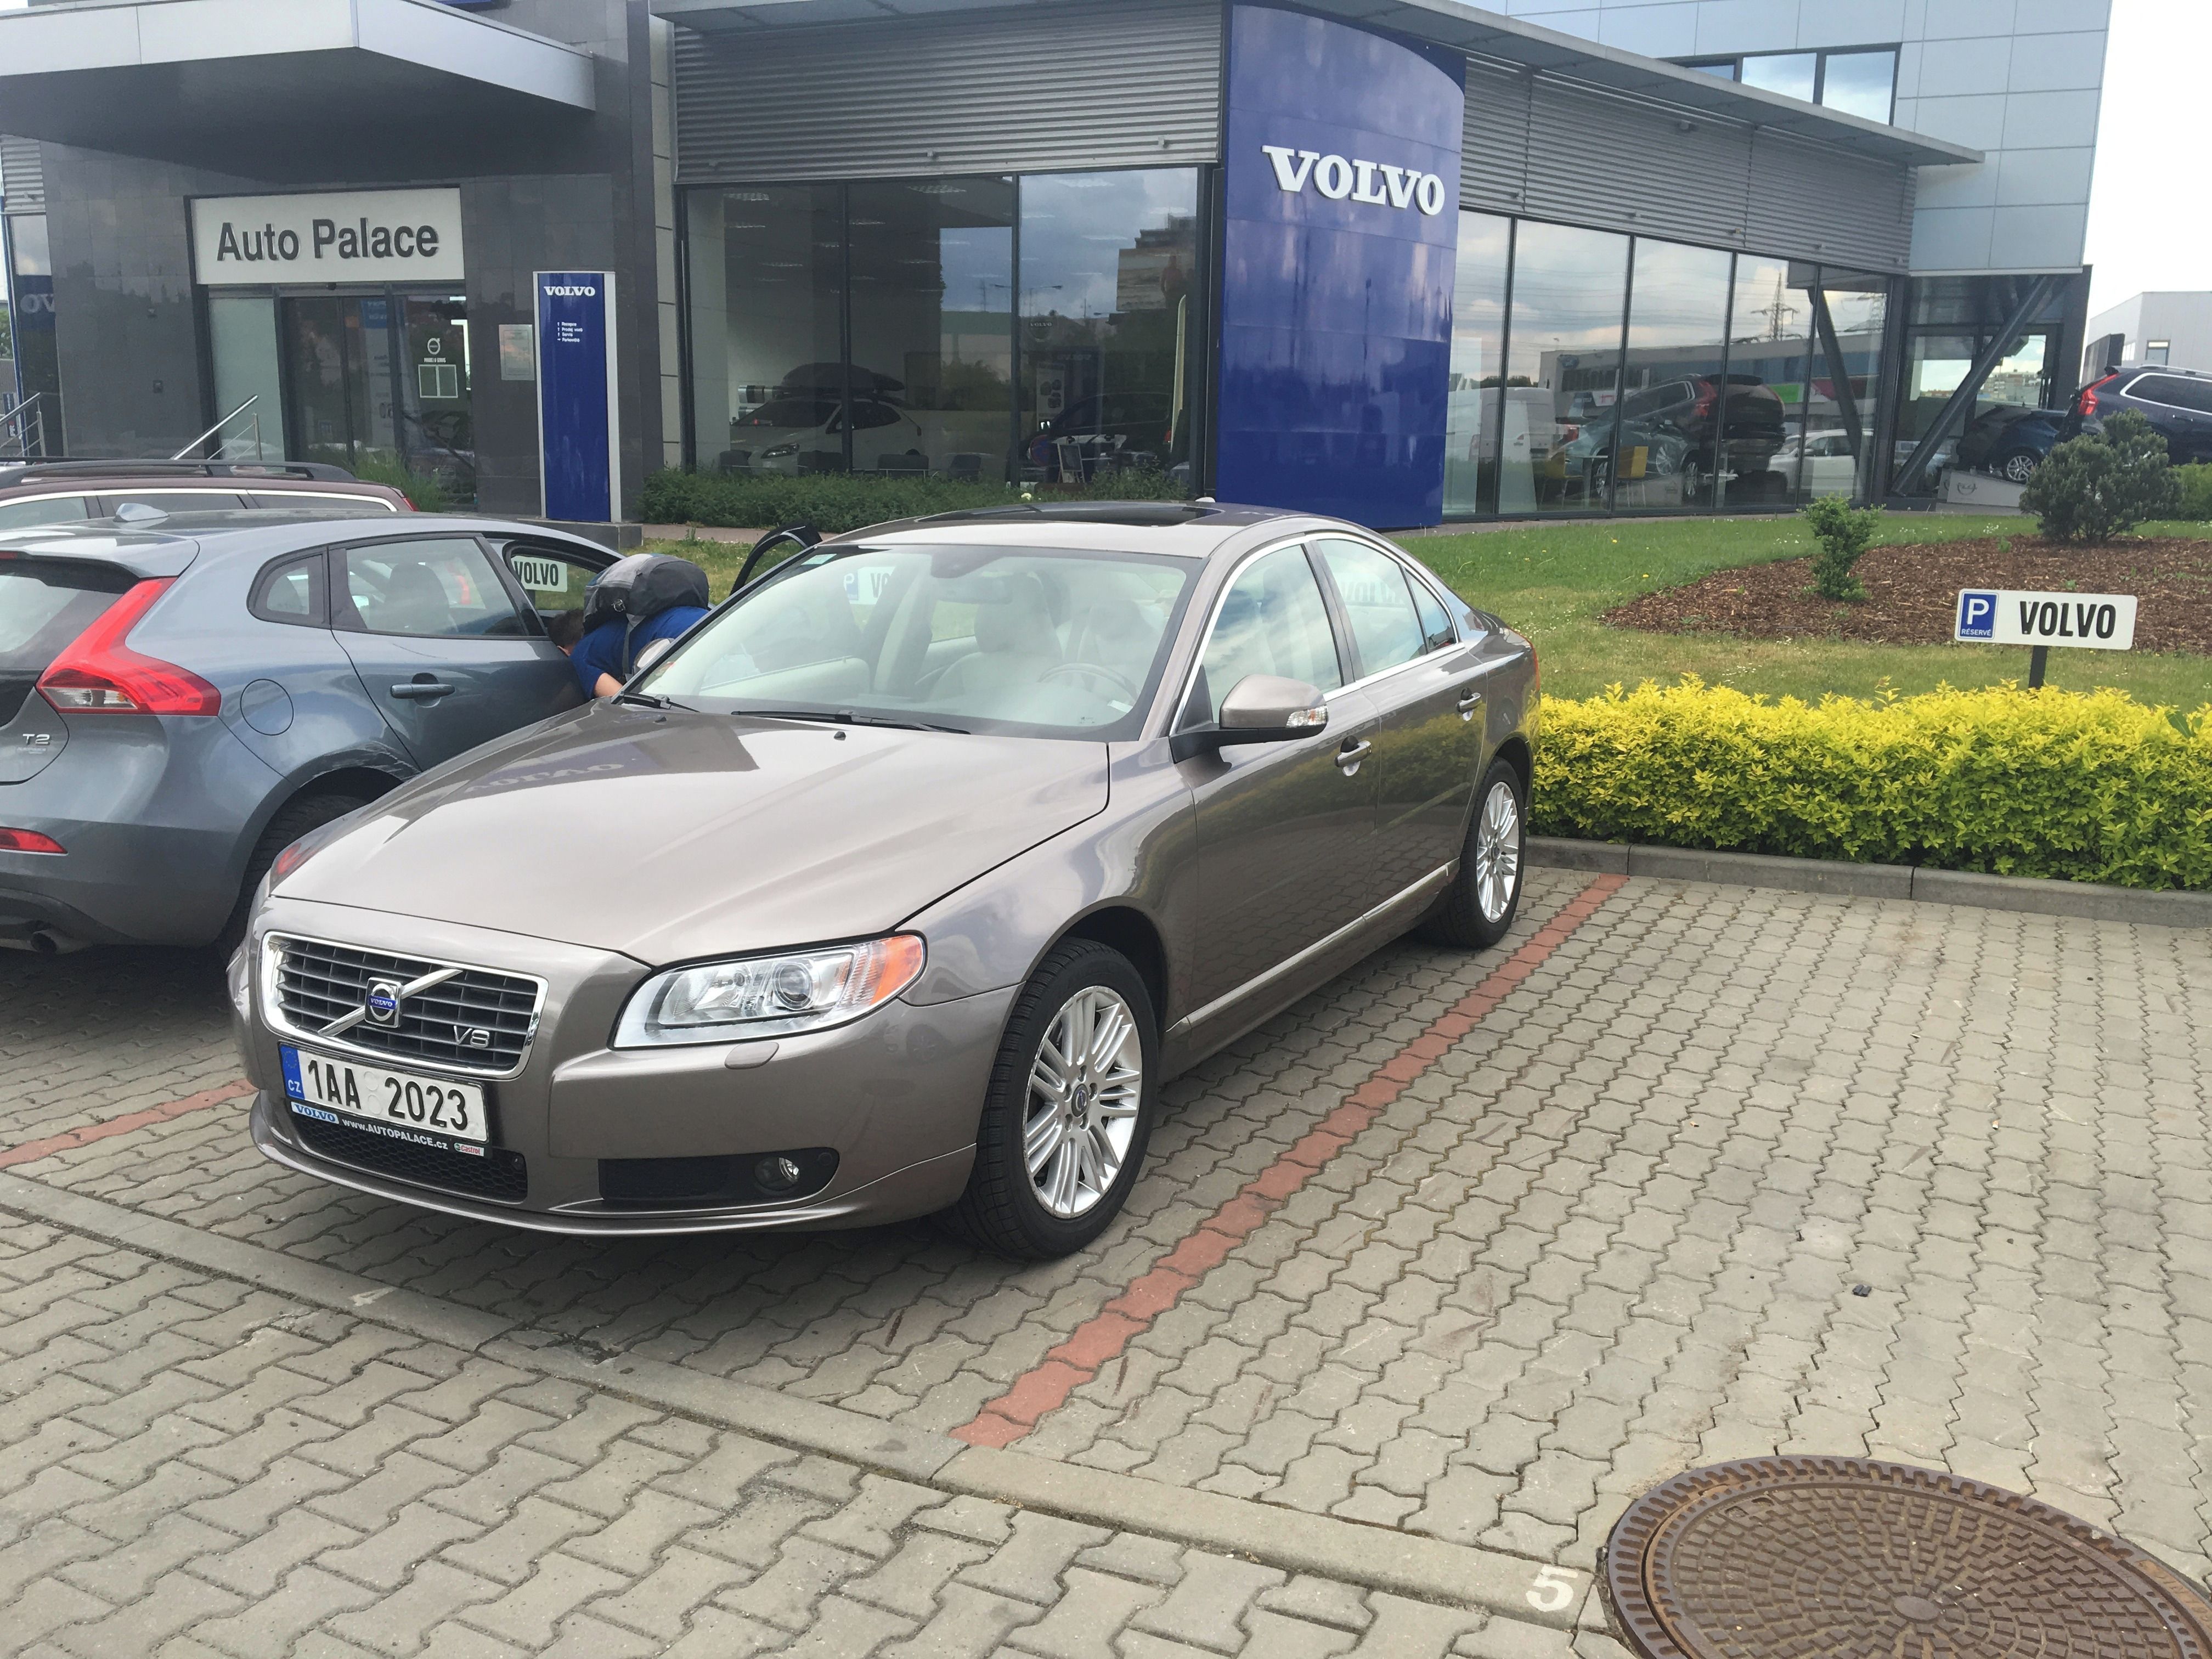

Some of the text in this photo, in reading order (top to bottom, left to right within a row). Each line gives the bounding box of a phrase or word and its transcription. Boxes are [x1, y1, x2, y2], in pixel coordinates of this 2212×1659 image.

[1261, 145, 1445, 216] VOLVO
[217, 217, 439, 261] Auto Palace
[543, 286, 596, 296] VOLVO
[514, 560, 559, 586] VOLVO
[1961, 627, 1992, 636] RÉSERVÉ
[1966, 598, 2116, 639] P VOLVO
[22, 733, 50, 745] T2
[370, 997, 393, 1007] VOLVO
[453, 1025, 490, 1049] V8
[287, 1079, 302, 1093] CZ
[307, 1059, 469, 1131] 1AA 2023
[294, 1103, 336, 1122] VOLVO
[460, 1144, 481, 1155] Castrol
[1525, 1565, 1578, 1612] 5
